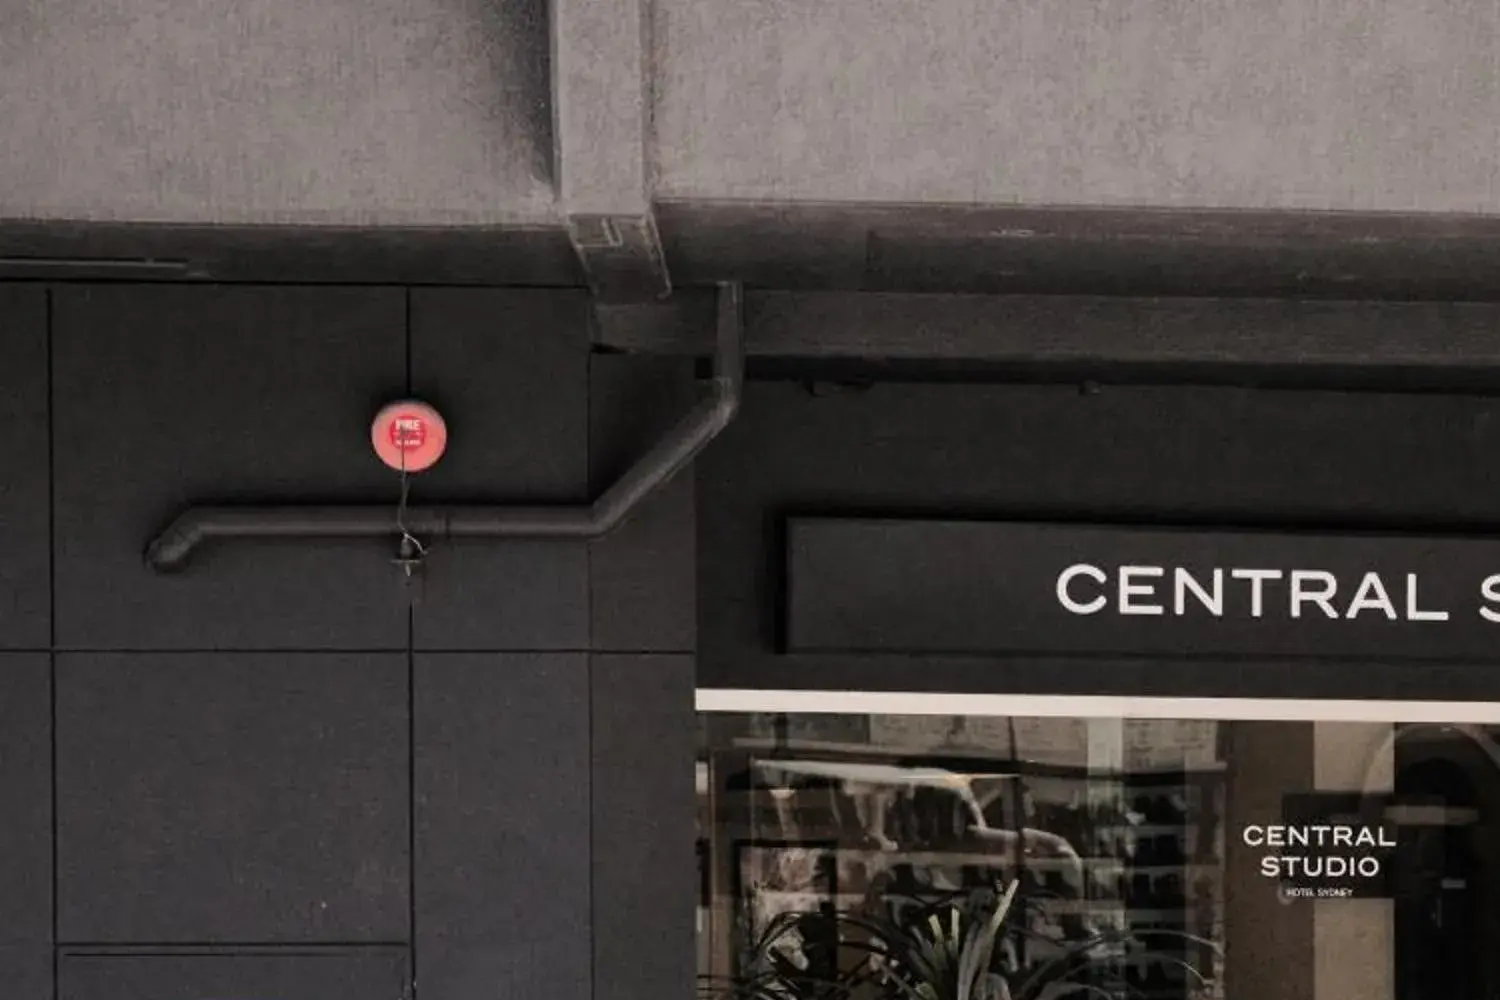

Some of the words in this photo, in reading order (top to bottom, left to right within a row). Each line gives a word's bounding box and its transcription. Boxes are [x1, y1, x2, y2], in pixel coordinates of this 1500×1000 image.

[1055, 563, 1450, 621] CENTRAL
[1243, 825, 1397, 847] CENTRAL
[1261, 855, 1380, 877] STUDIO
